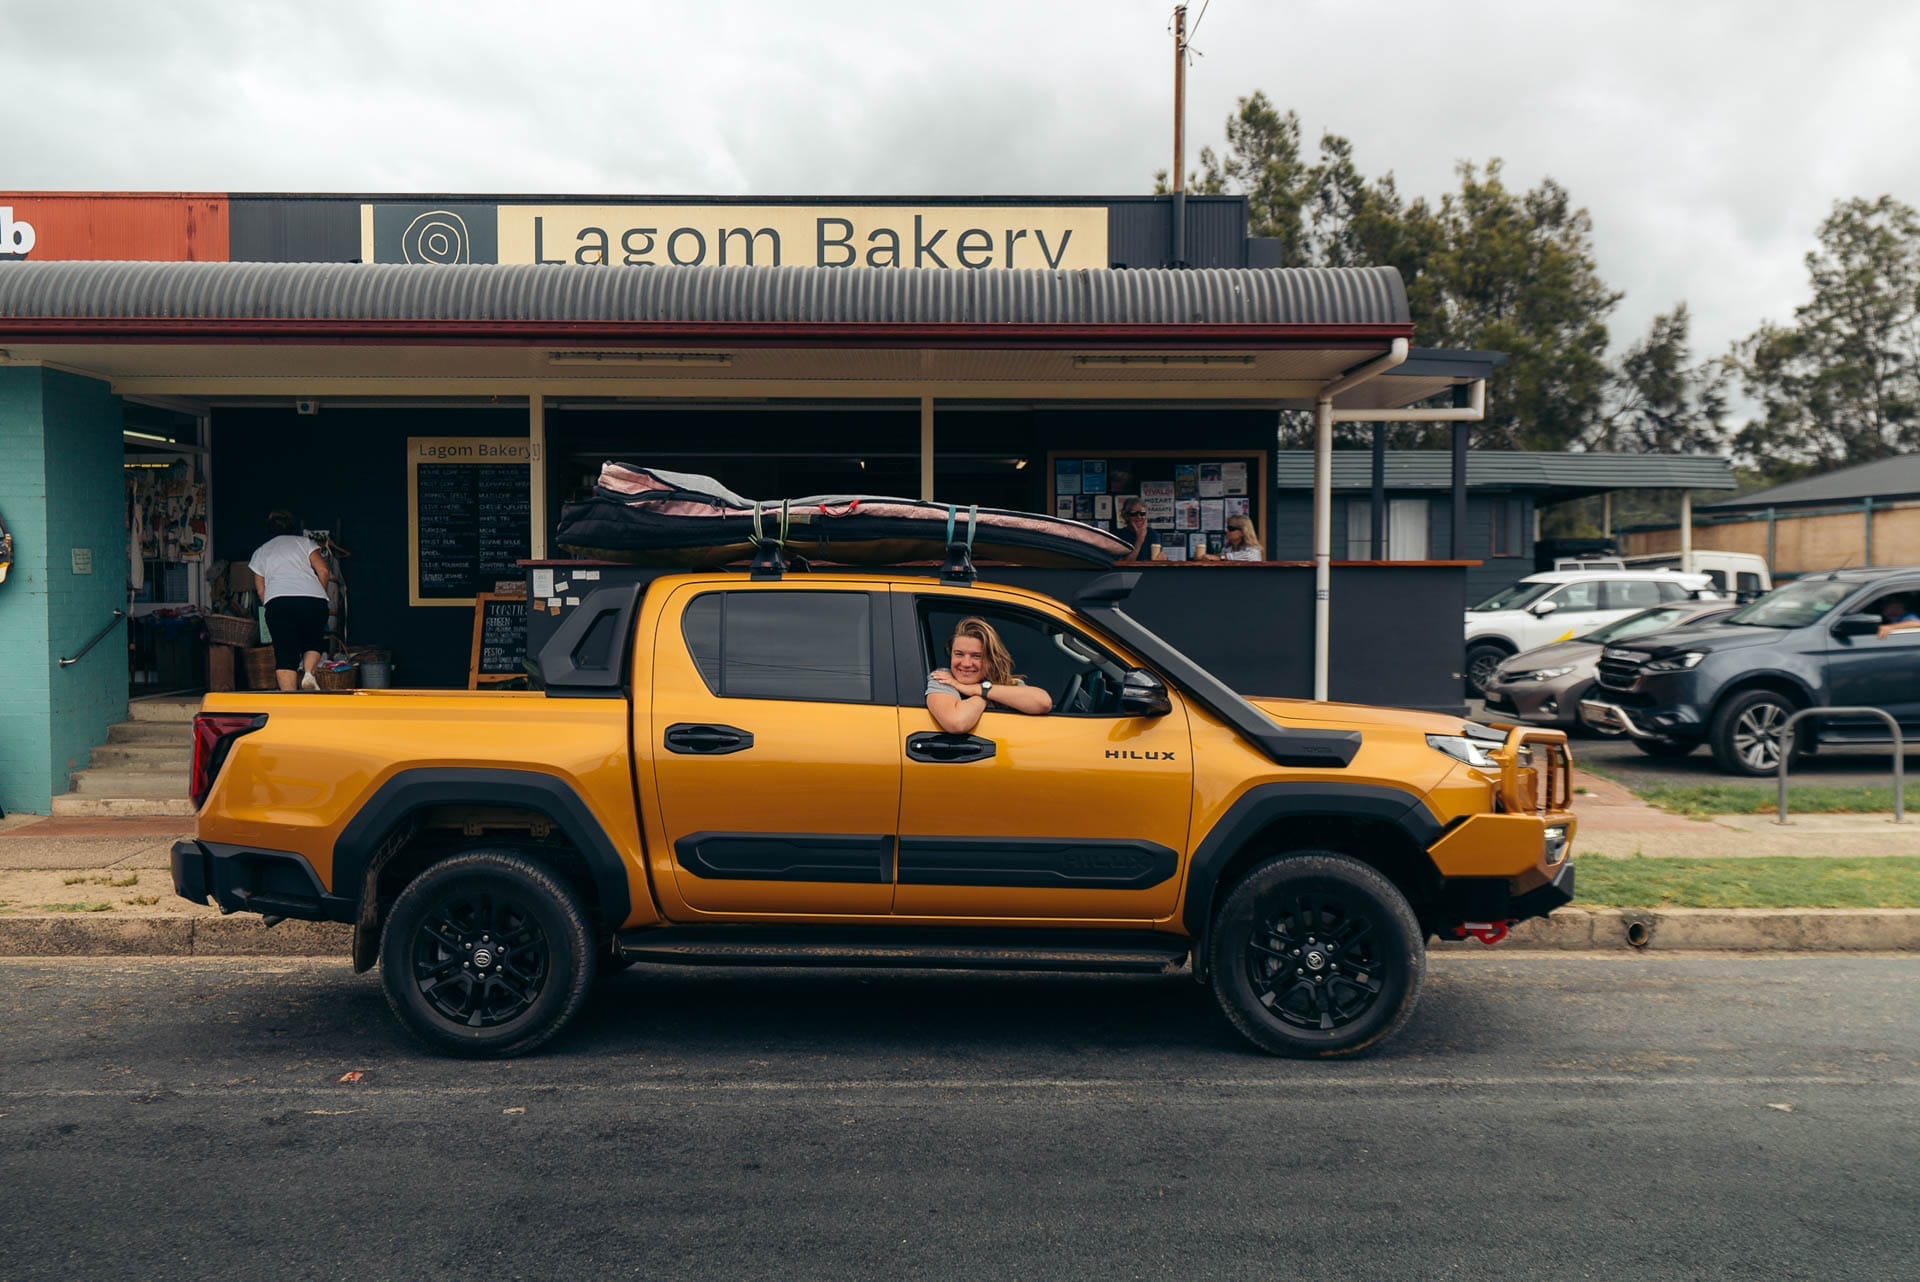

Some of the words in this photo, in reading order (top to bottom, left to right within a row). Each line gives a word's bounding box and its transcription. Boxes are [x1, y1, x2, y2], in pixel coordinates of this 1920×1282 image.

[534, 215, 782, 266] Lagom
[815, 214, 1073, 269] Bakery
[419, 443, 473, 459] Lagom
[479, 443, 531, 459] Bakery
[1143, 487, 1172, 495] VIVALDI
[1105, 750, 1175, 761] HILUX
